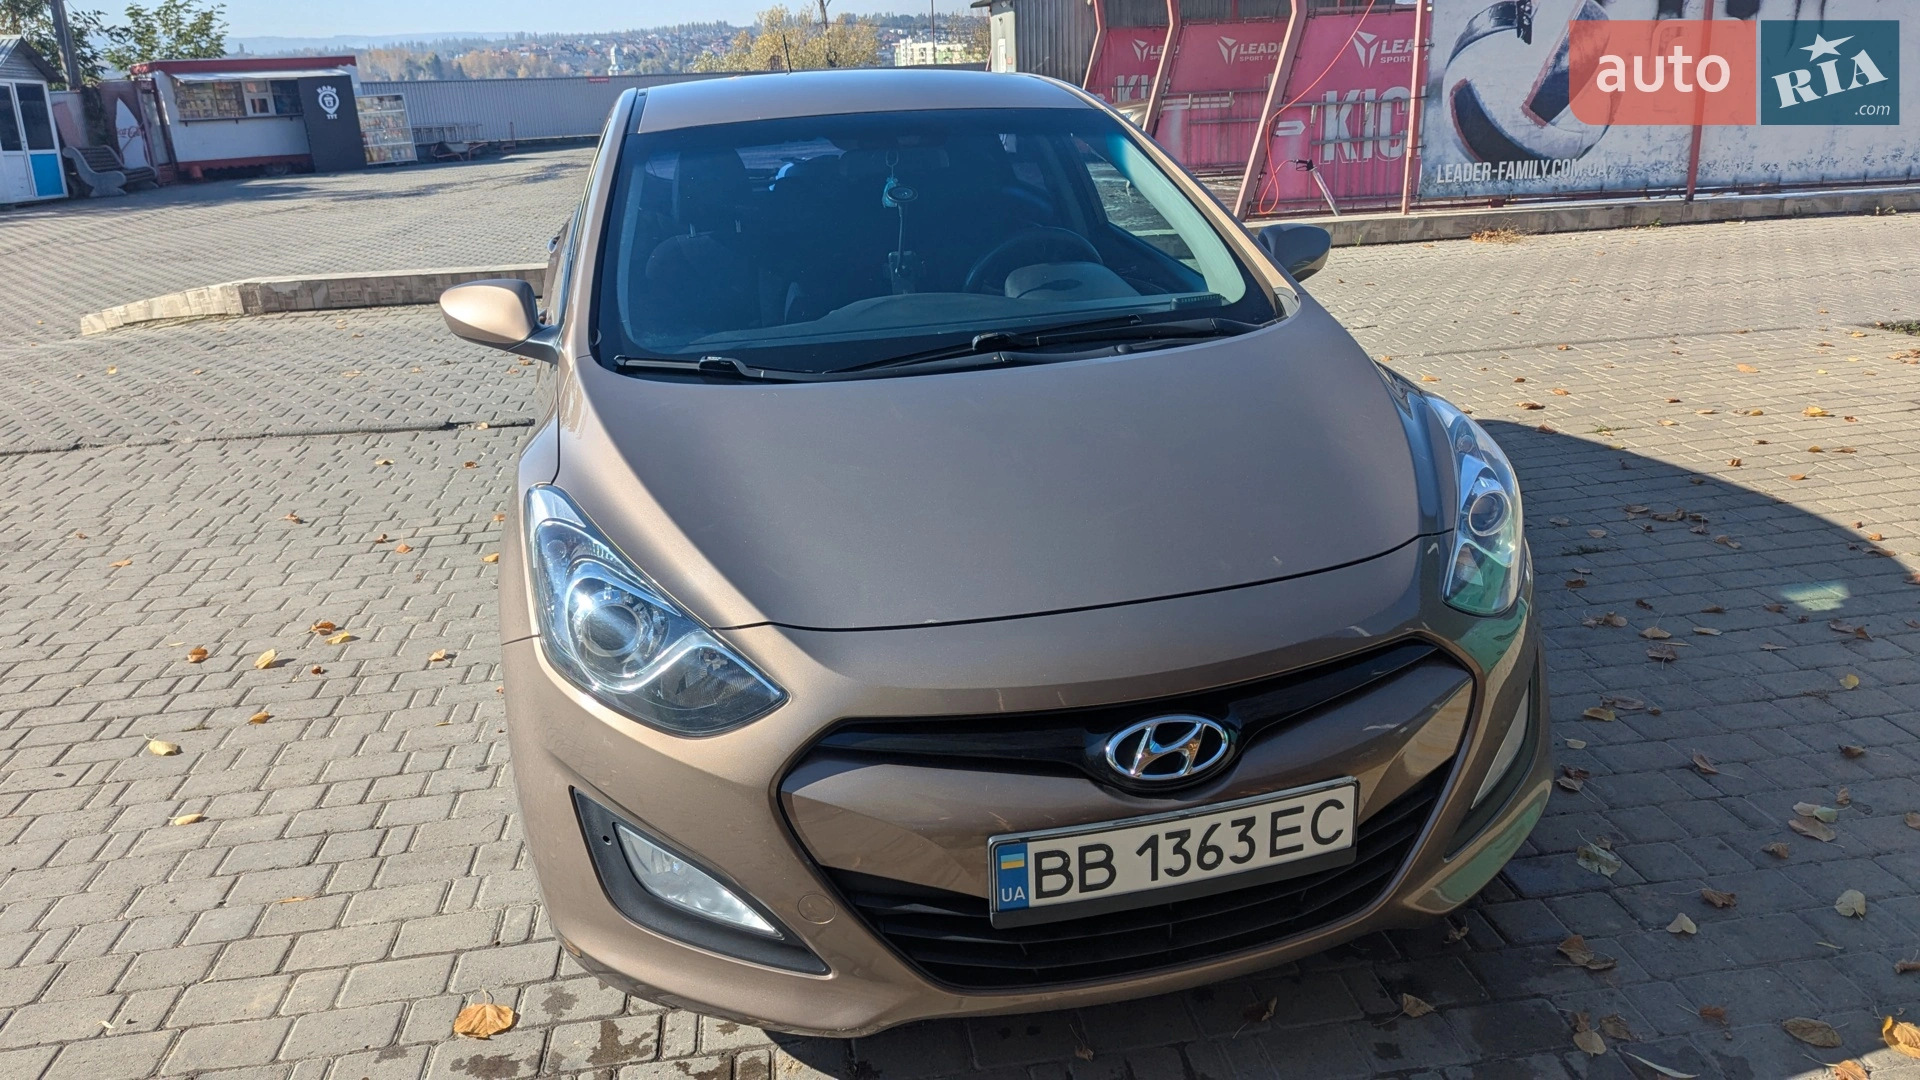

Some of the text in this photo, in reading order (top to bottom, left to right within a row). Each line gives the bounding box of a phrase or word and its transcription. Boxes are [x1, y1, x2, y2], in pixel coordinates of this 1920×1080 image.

[1380, 55, 1411, 64] SPORT
[1319, 86, 1425, 164] KIC
[1034, 798, 1345, 900] BB 1363 EC
[1001, 886, 1026, 902] UA
